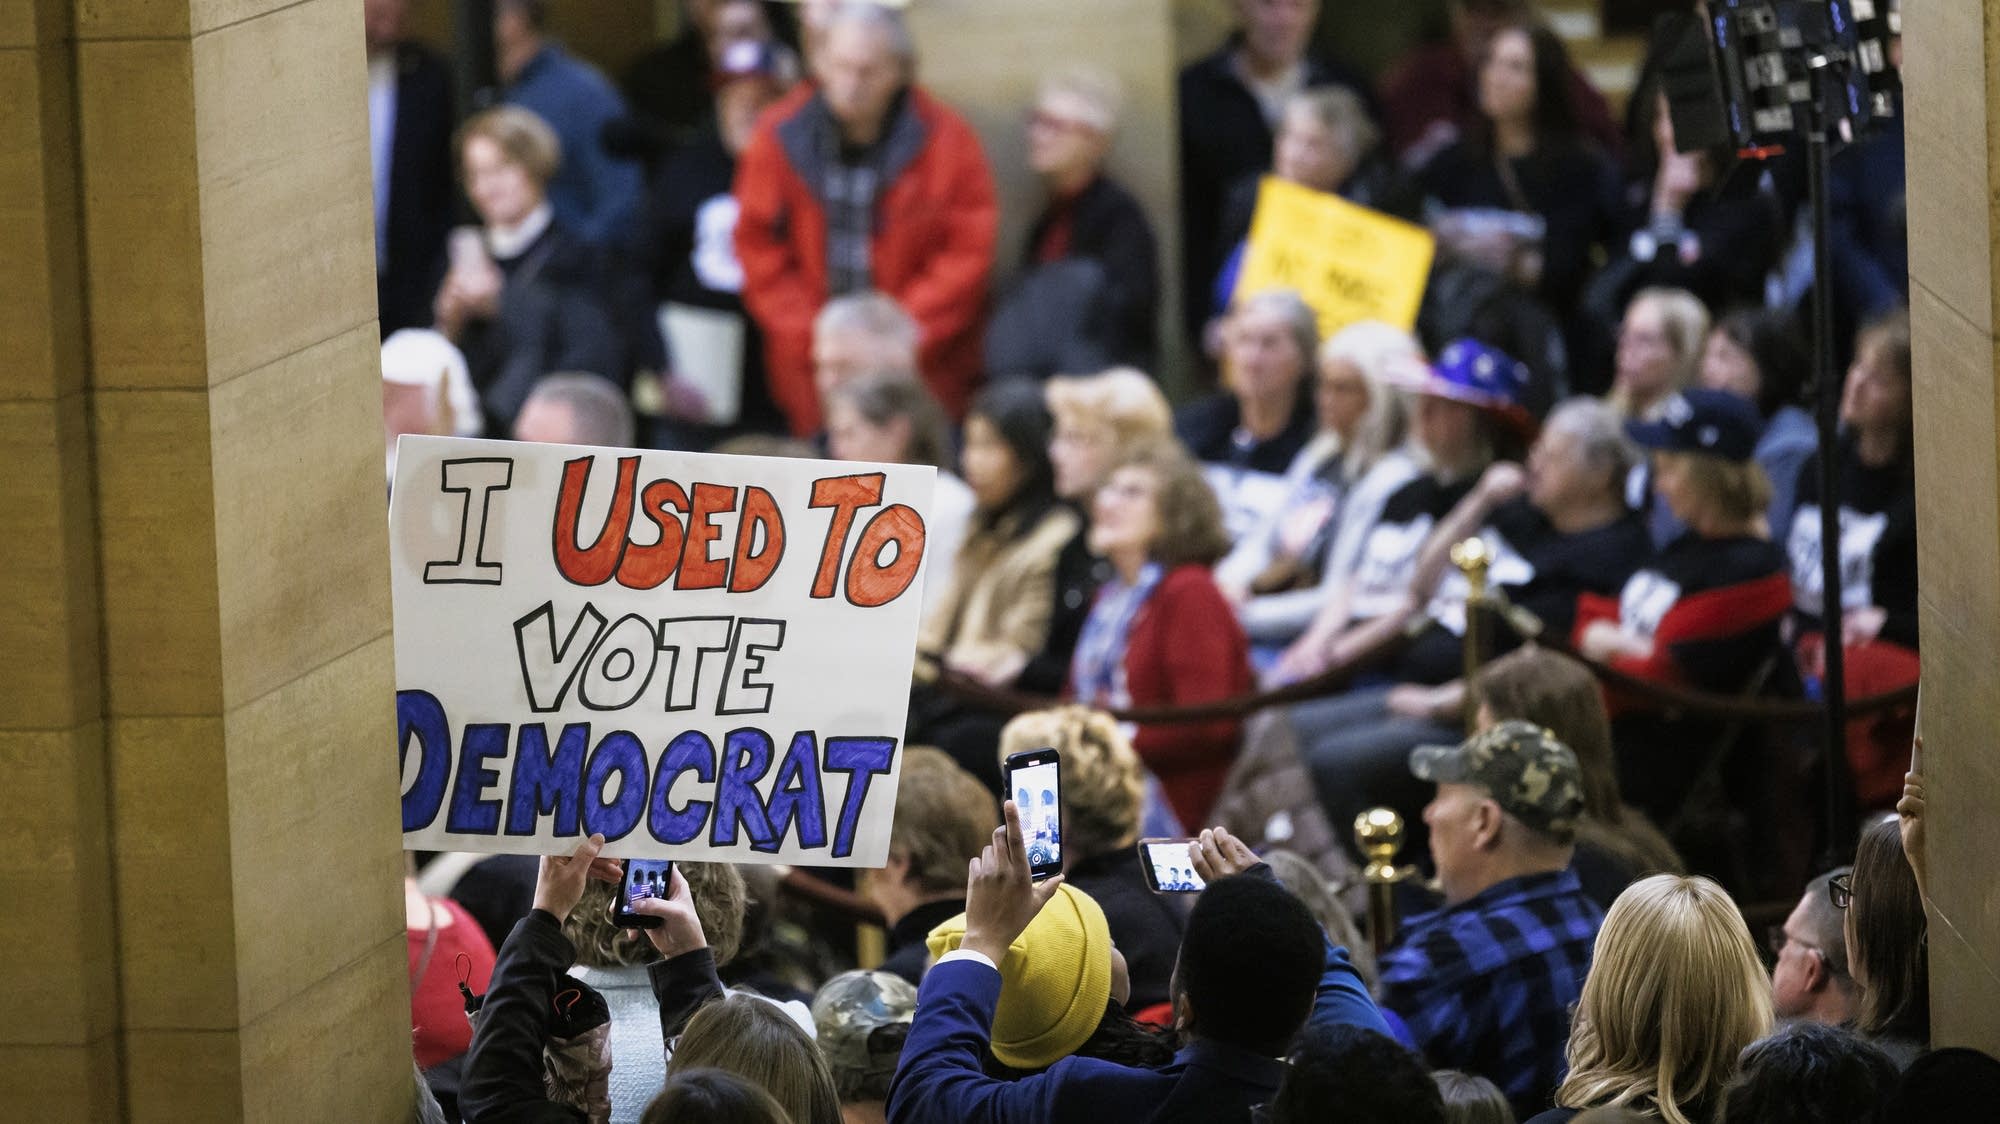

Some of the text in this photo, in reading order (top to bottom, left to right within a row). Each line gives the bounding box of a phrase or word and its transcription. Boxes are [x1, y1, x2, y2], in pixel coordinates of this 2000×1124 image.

[424, 455, 926, 607] I USED TO
[513, 600, 786, 715] VOTE
[396, 689, 898, 858] DEMOCRAT
